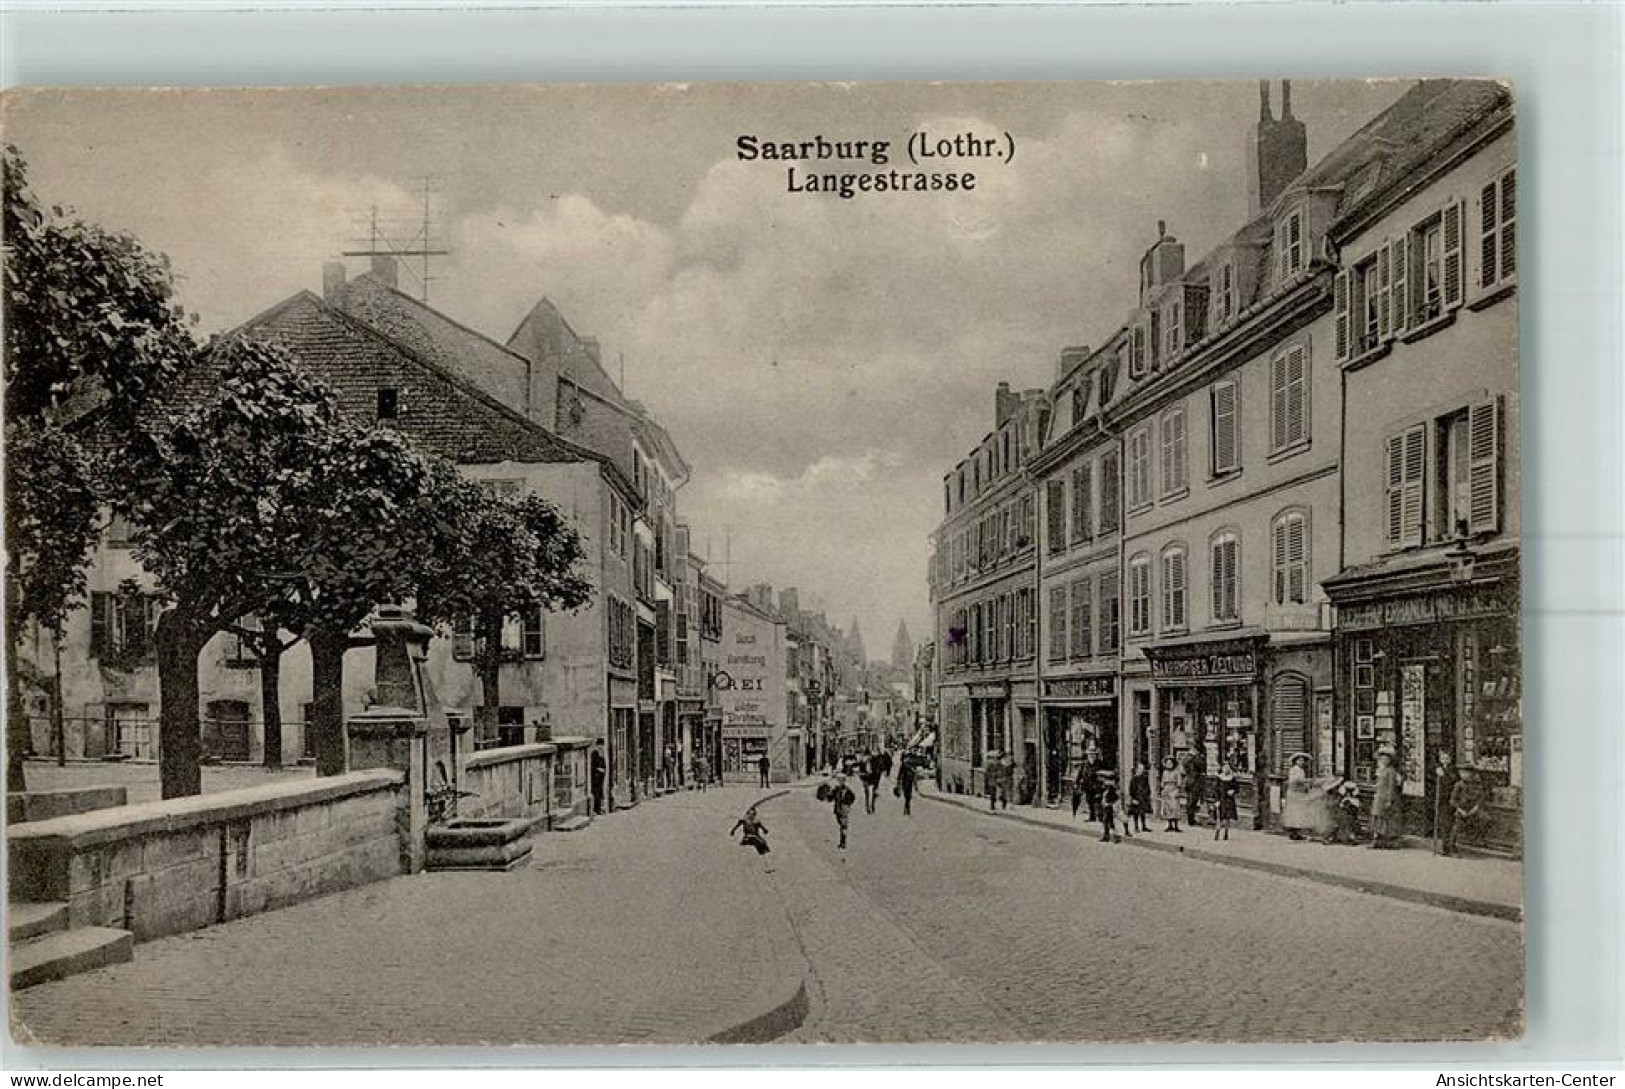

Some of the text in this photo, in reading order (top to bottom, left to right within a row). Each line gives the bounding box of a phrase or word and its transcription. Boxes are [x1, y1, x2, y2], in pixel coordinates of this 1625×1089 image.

[737, 131, 1015, 165] Saarburg (Lothr.)
[787, 167, 976, 199] Langestrasse
